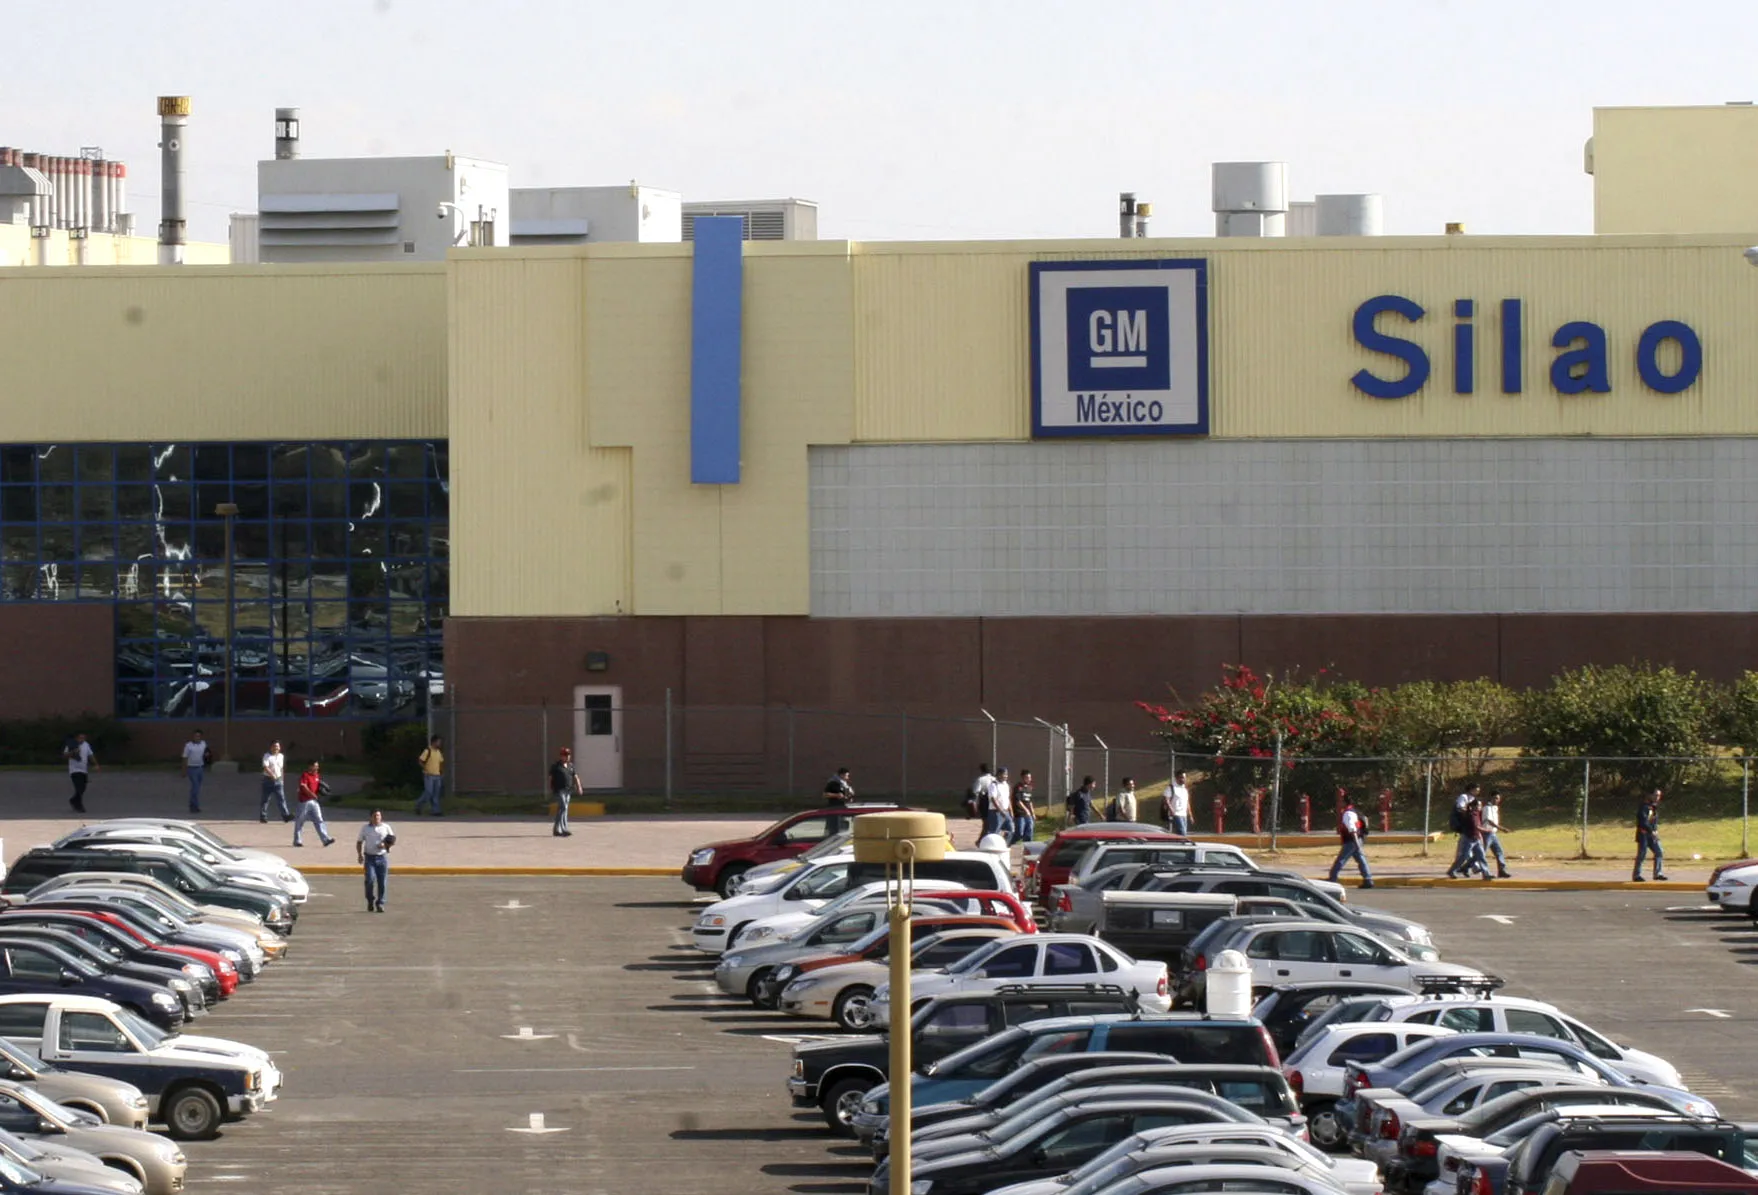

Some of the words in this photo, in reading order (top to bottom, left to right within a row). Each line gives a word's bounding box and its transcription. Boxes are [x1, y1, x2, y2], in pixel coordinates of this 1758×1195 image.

[1089, 310, 1147, 353] GM
[1351, 295, 1703, 399] Silao
[1076, 394, 1163, 424] México
